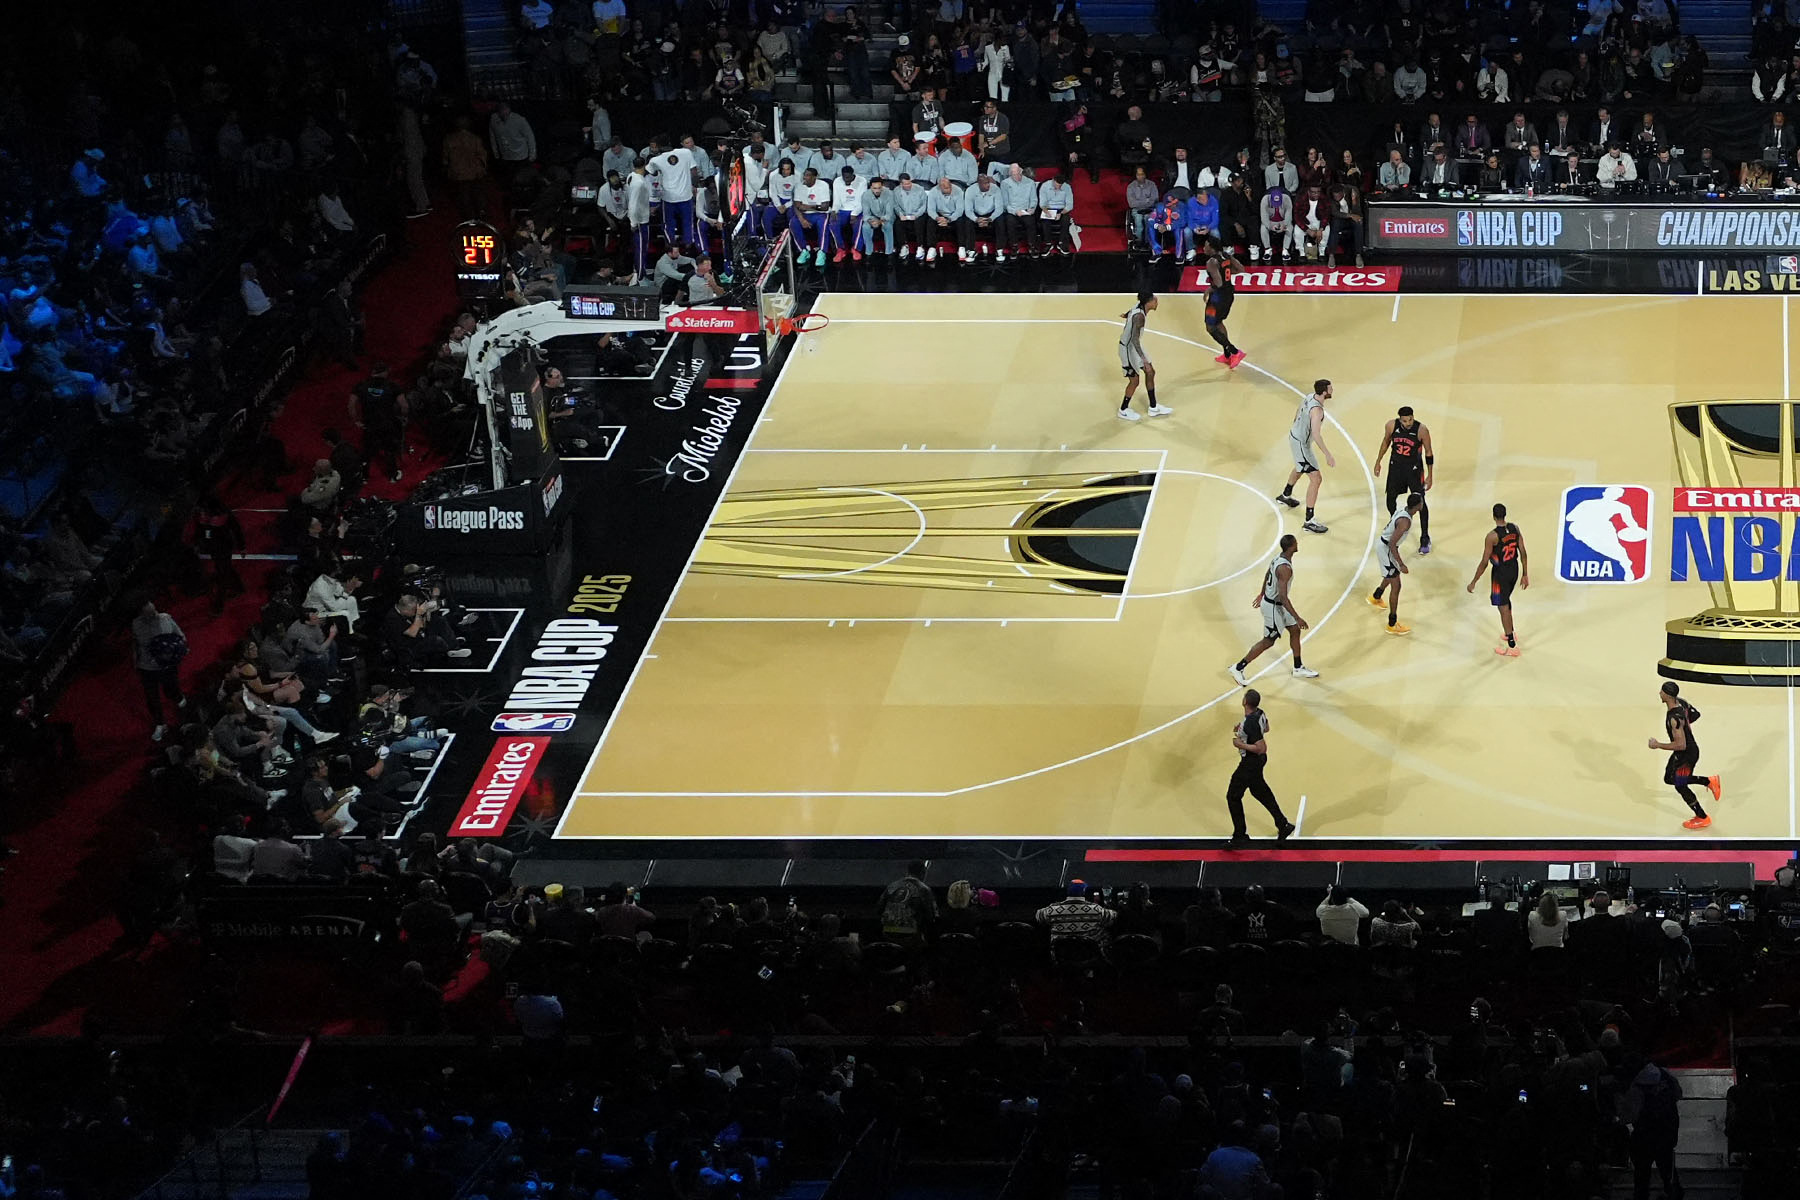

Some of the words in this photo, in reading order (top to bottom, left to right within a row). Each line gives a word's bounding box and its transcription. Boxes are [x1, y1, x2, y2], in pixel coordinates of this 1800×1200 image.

[1384, 220, 1445, 235] Emirates
[1477, 212, 1518, 246] NBA
[1522, 212, 1562, 246] CUP
[463, 236, 494, 248] 11:55
[464, 248, 490, 264] 21
[1196, 268, 1387, 287] Emirates
[1709, 271, 1761, 291] LAS
[582, 302, 599, 316] NBA
[599, 302, 616, 316] CUP
[510, 392, 525, 404] GET
[512, 404, 528, 415] THE
[518, 417, 533, 430] App
[665, 395, 742, 483] Michelob
[1396, 445, 1410, 456] 32
[437, 506, 487, 533] League
[489, 506, 524, 529] Pass
[1502, 543, 1517, 562] 25
[1569, 560, 1614, 578] NBA
[568, 574, 632, 613] 2025
[531, 617, 619, 661] CUP
[503, 663, 600, 709] NBA
[459, 742, 535, 830] Emirates
